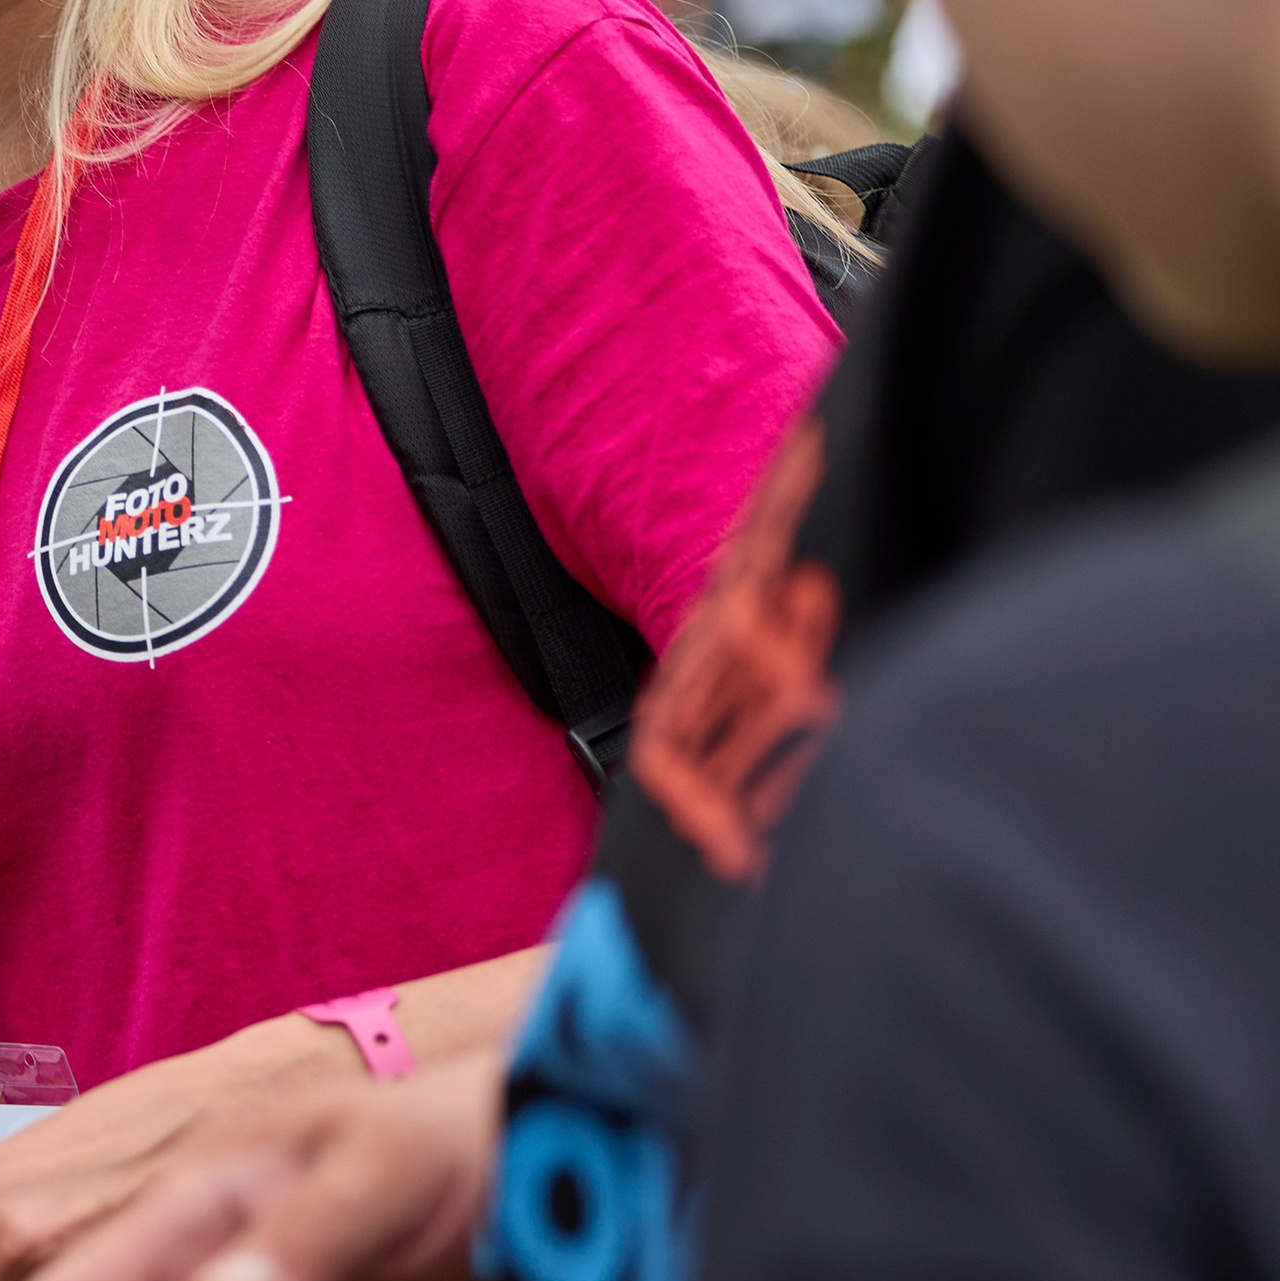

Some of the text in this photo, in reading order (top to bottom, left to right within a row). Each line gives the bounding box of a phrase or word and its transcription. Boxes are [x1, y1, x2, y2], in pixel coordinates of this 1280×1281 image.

[98, 496, 193, 546] MOTO
[104, 472, 189, 522] FOTO
[69, 512, 233, 576] HUNTERZ
